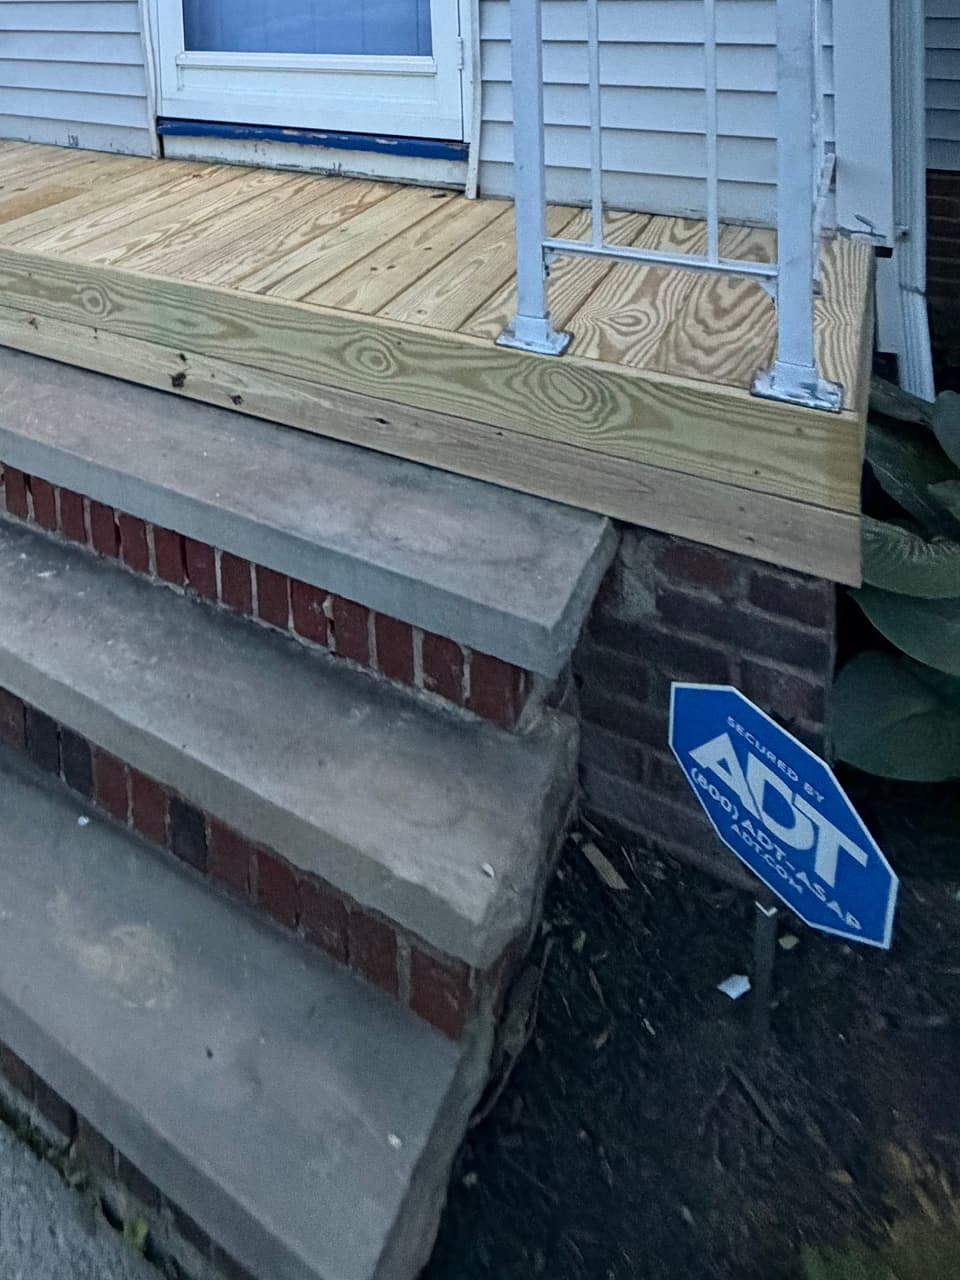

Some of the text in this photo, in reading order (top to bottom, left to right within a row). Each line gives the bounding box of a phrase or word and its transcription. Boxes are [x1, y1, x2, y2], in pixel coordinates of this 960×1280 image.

[688, 732, 868, 888] ADT
[727, 716, 825, 803] SECURED BY
[691, 767, 862, 930] (800) ADT-ASAP
[731, 823, 803, 894] ADT.COM
